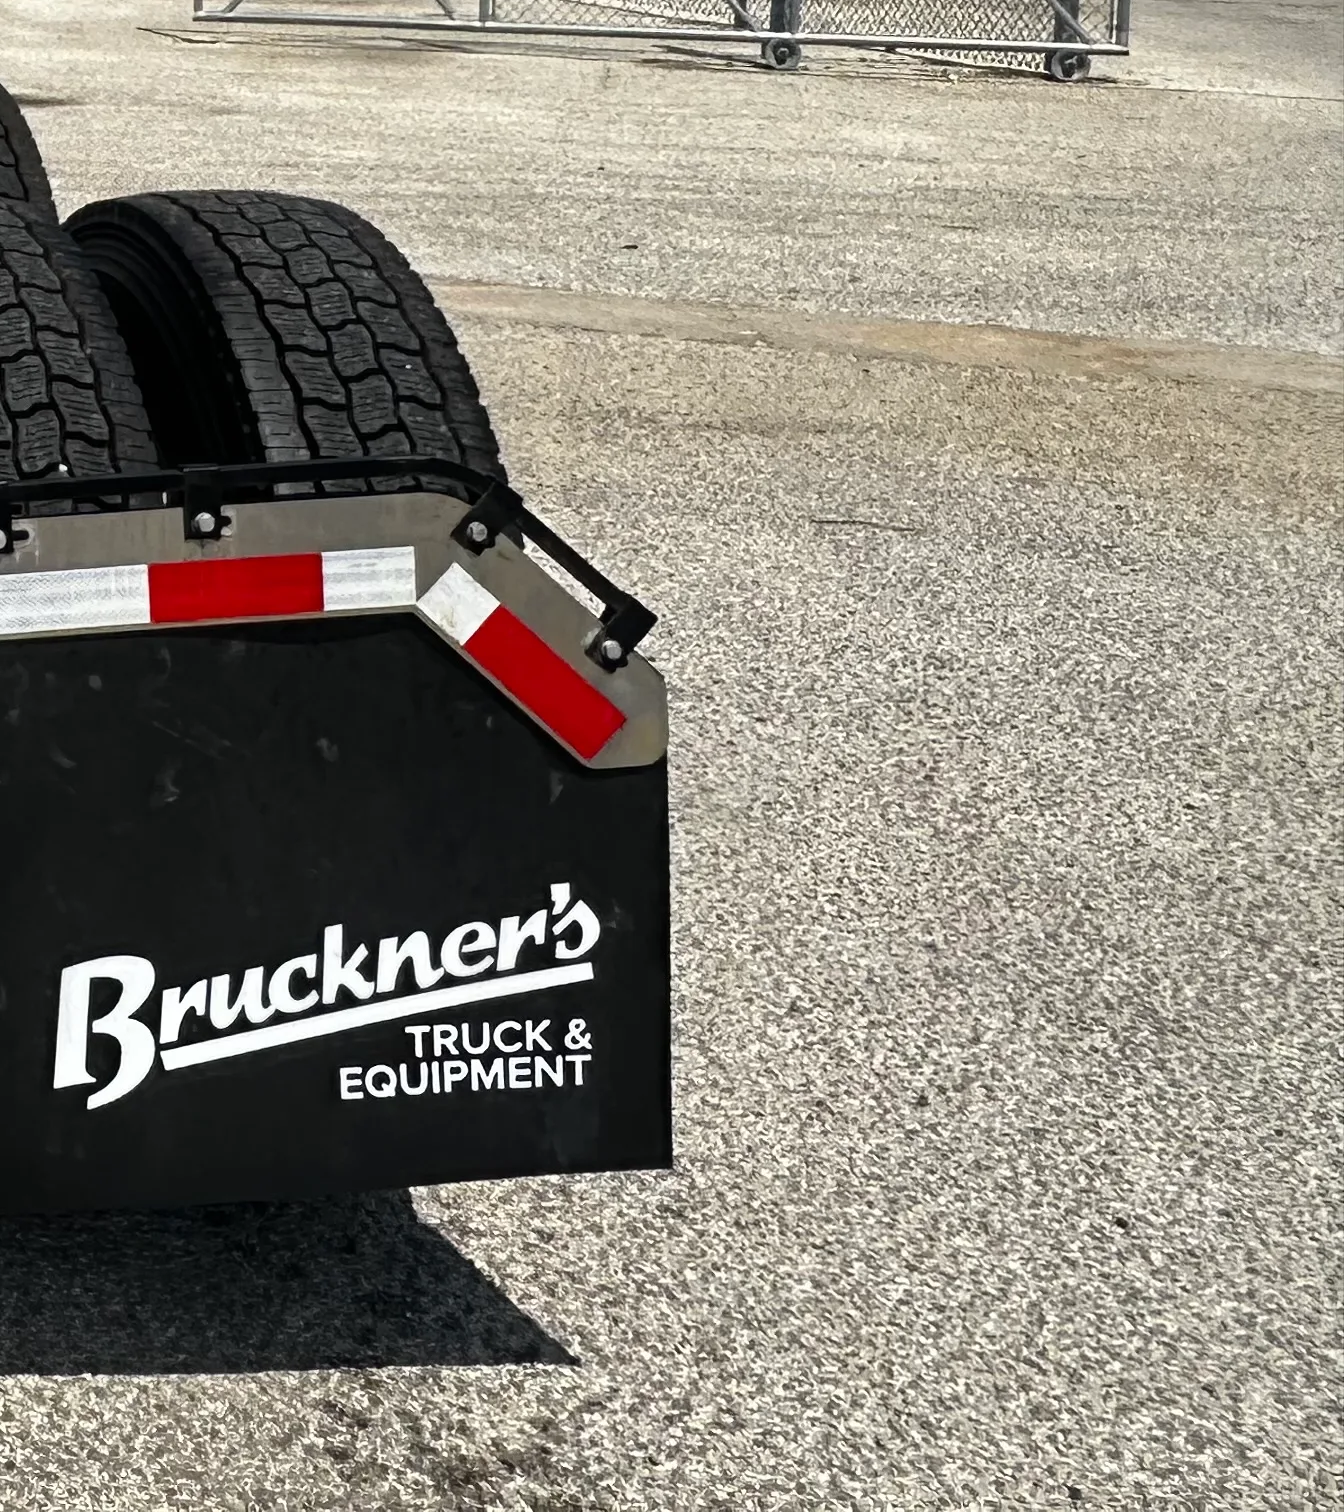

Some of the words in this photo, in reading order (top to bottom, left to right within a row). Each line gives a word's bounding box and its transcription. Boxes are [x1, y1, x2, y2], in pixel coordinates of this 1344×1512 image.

[52, 881, 601, 1111] Bruckner's
[404, 1020, 553, 1059] TRUCK
[563, 1018, 594, 1051] &
[339, 1053, 593, 1100] EQUIPMENT
